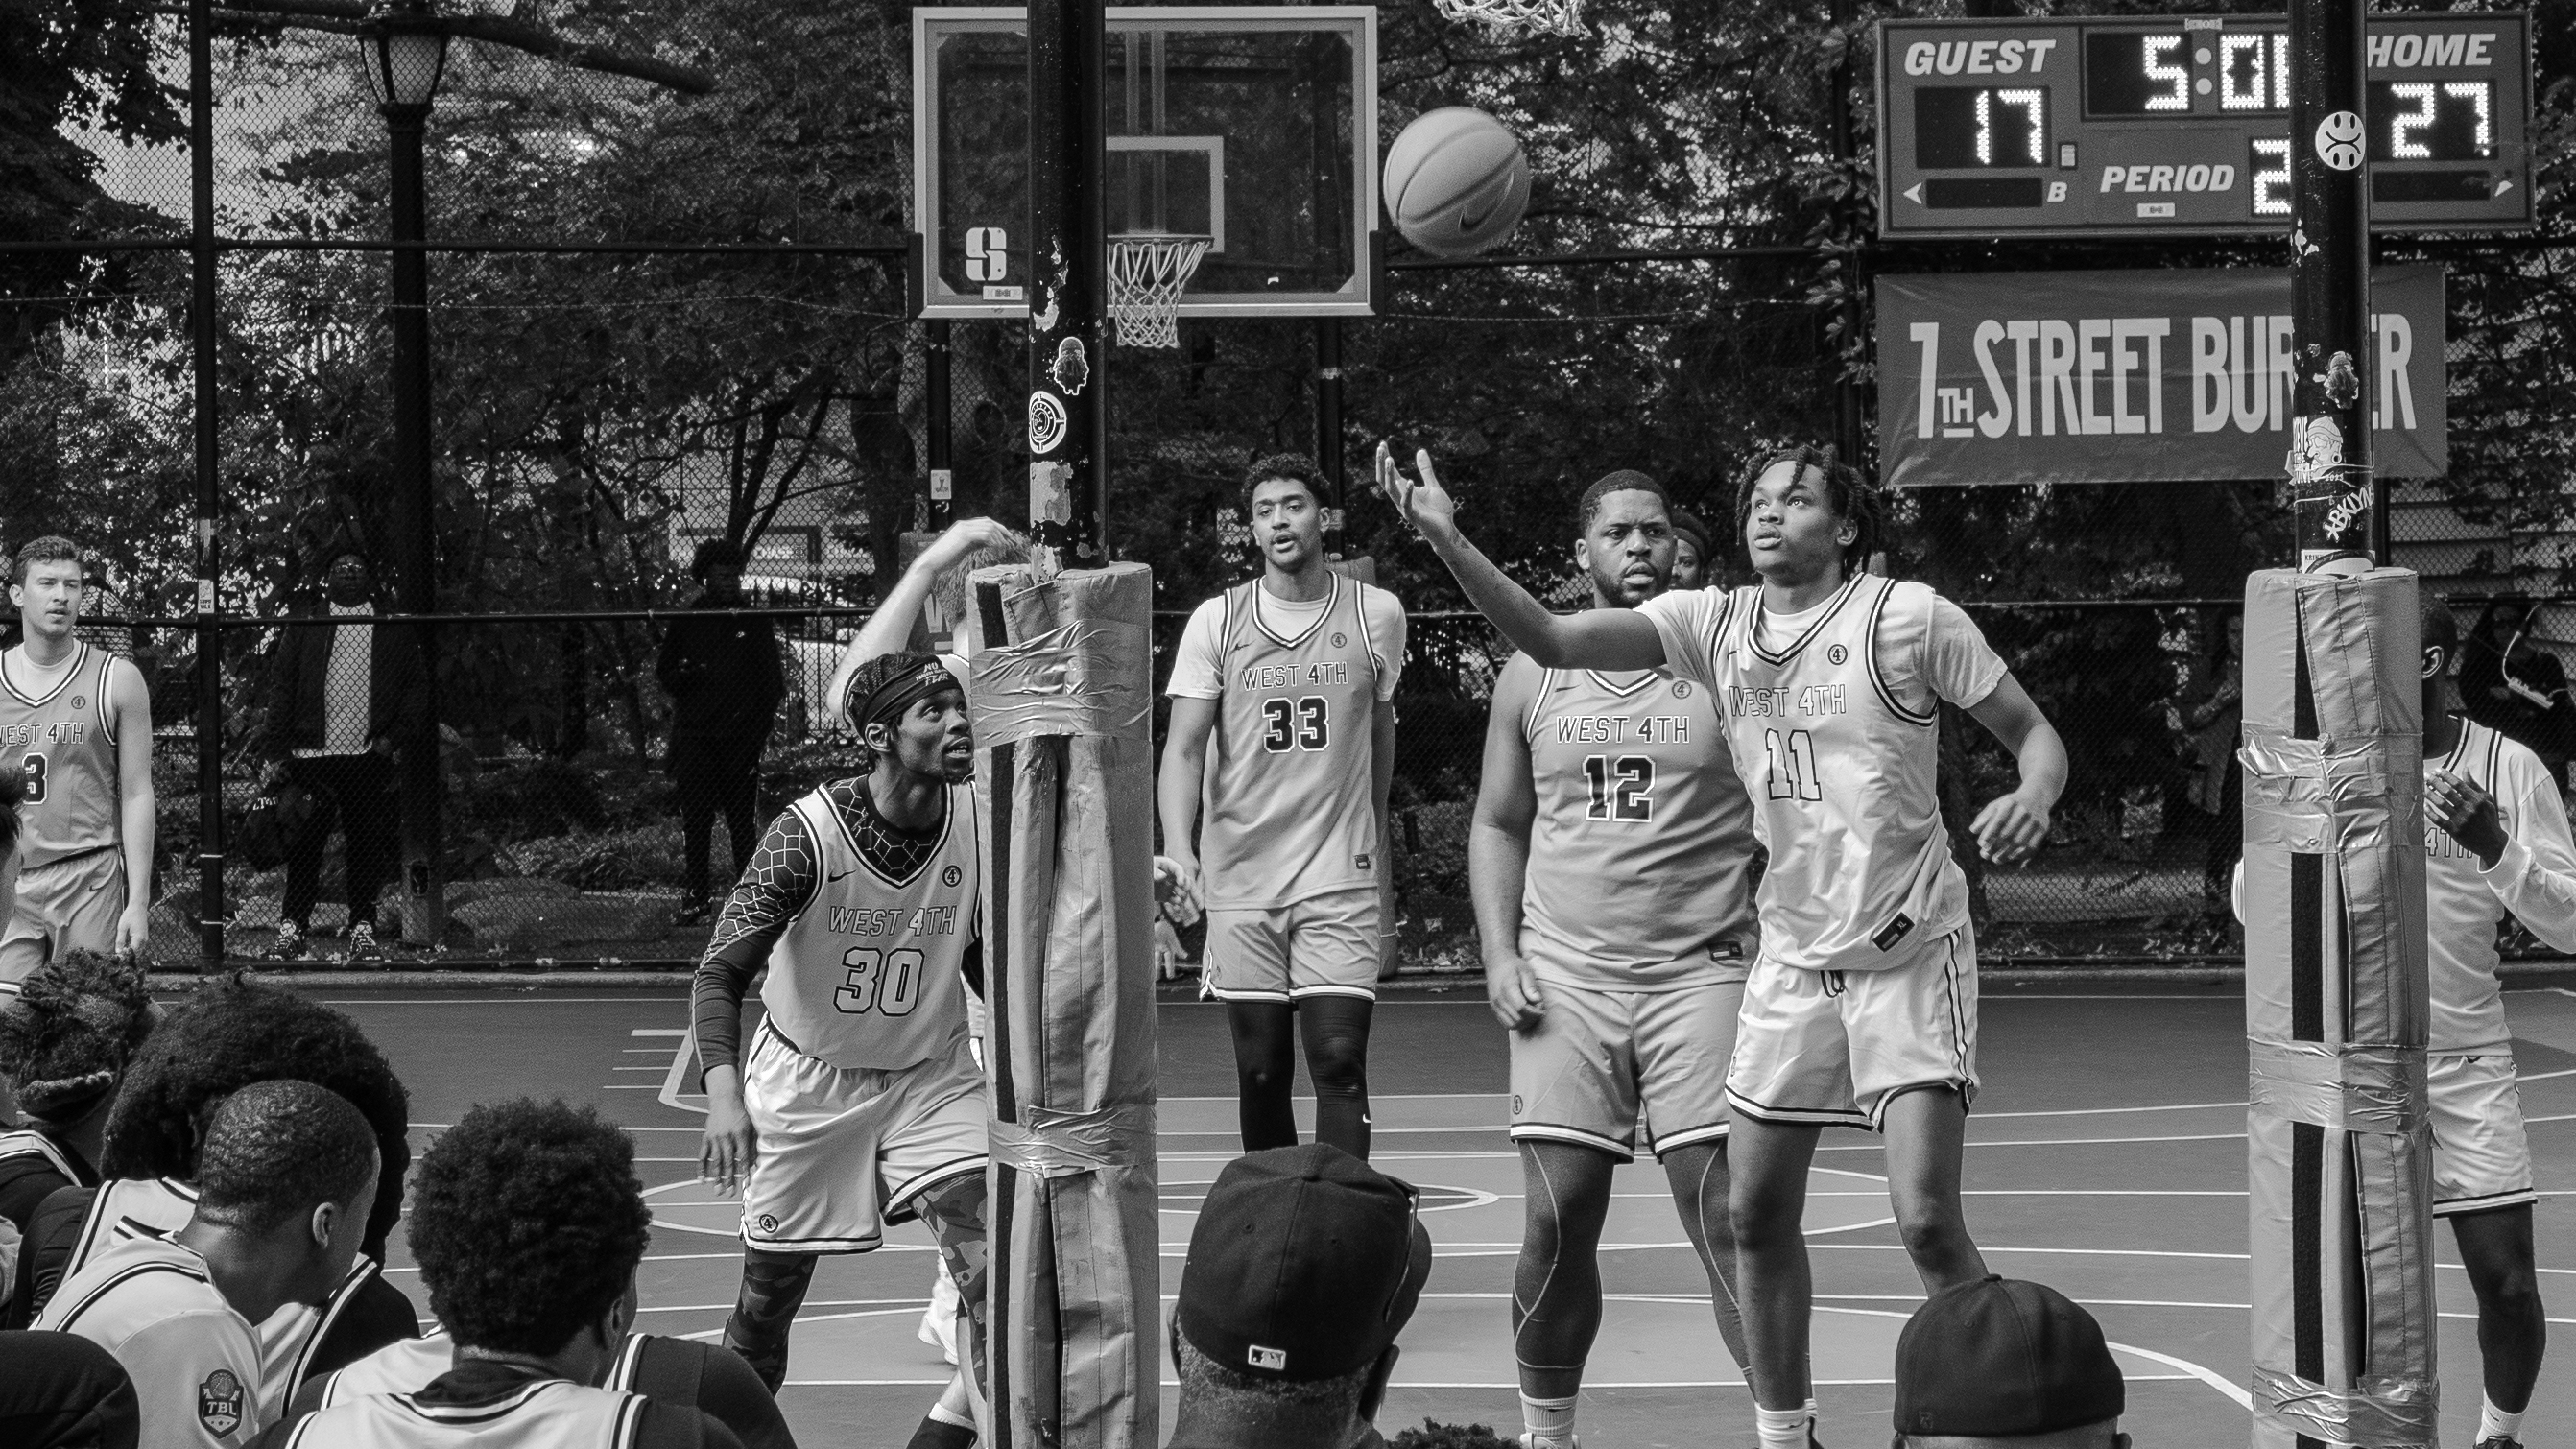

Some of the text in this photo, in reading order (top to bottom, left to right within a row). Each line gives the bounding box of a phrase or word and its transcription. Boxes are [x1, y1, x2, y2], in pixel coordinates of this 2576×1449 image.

[1904, 39, 2057, 76] GUEST
[2367, 34, 2496, 68] HOME
[1975, 89, 2043, 165] 17
[2390, 83, 2489, 159] 27
[2047, 181, 2067, 202] B
[2100, 164, 2235, 193] PERIOD
[2253, 139, 2292, 213] 2
[1973, 318, 2170, 439] STREET
[2192, 313, 2417, 433] BURR
[1241, 662, 1348, 691] WEST 4TH
[1729, 684, 1847, 717] WEST 4TH
[46, 722, 84, 745] 4TH
[1262, 695, 1330, 753] 33
[1557, 715, 1690, 744] WEST 4TH
[1765, 727, 1823, 802] 11
[1583, 754, 1656, 823] 12
[828, 905, 957, 937] WEST 4TH
[833, 946, 925, 1017] 30
[207, 1401, 237, 1416] TBL
